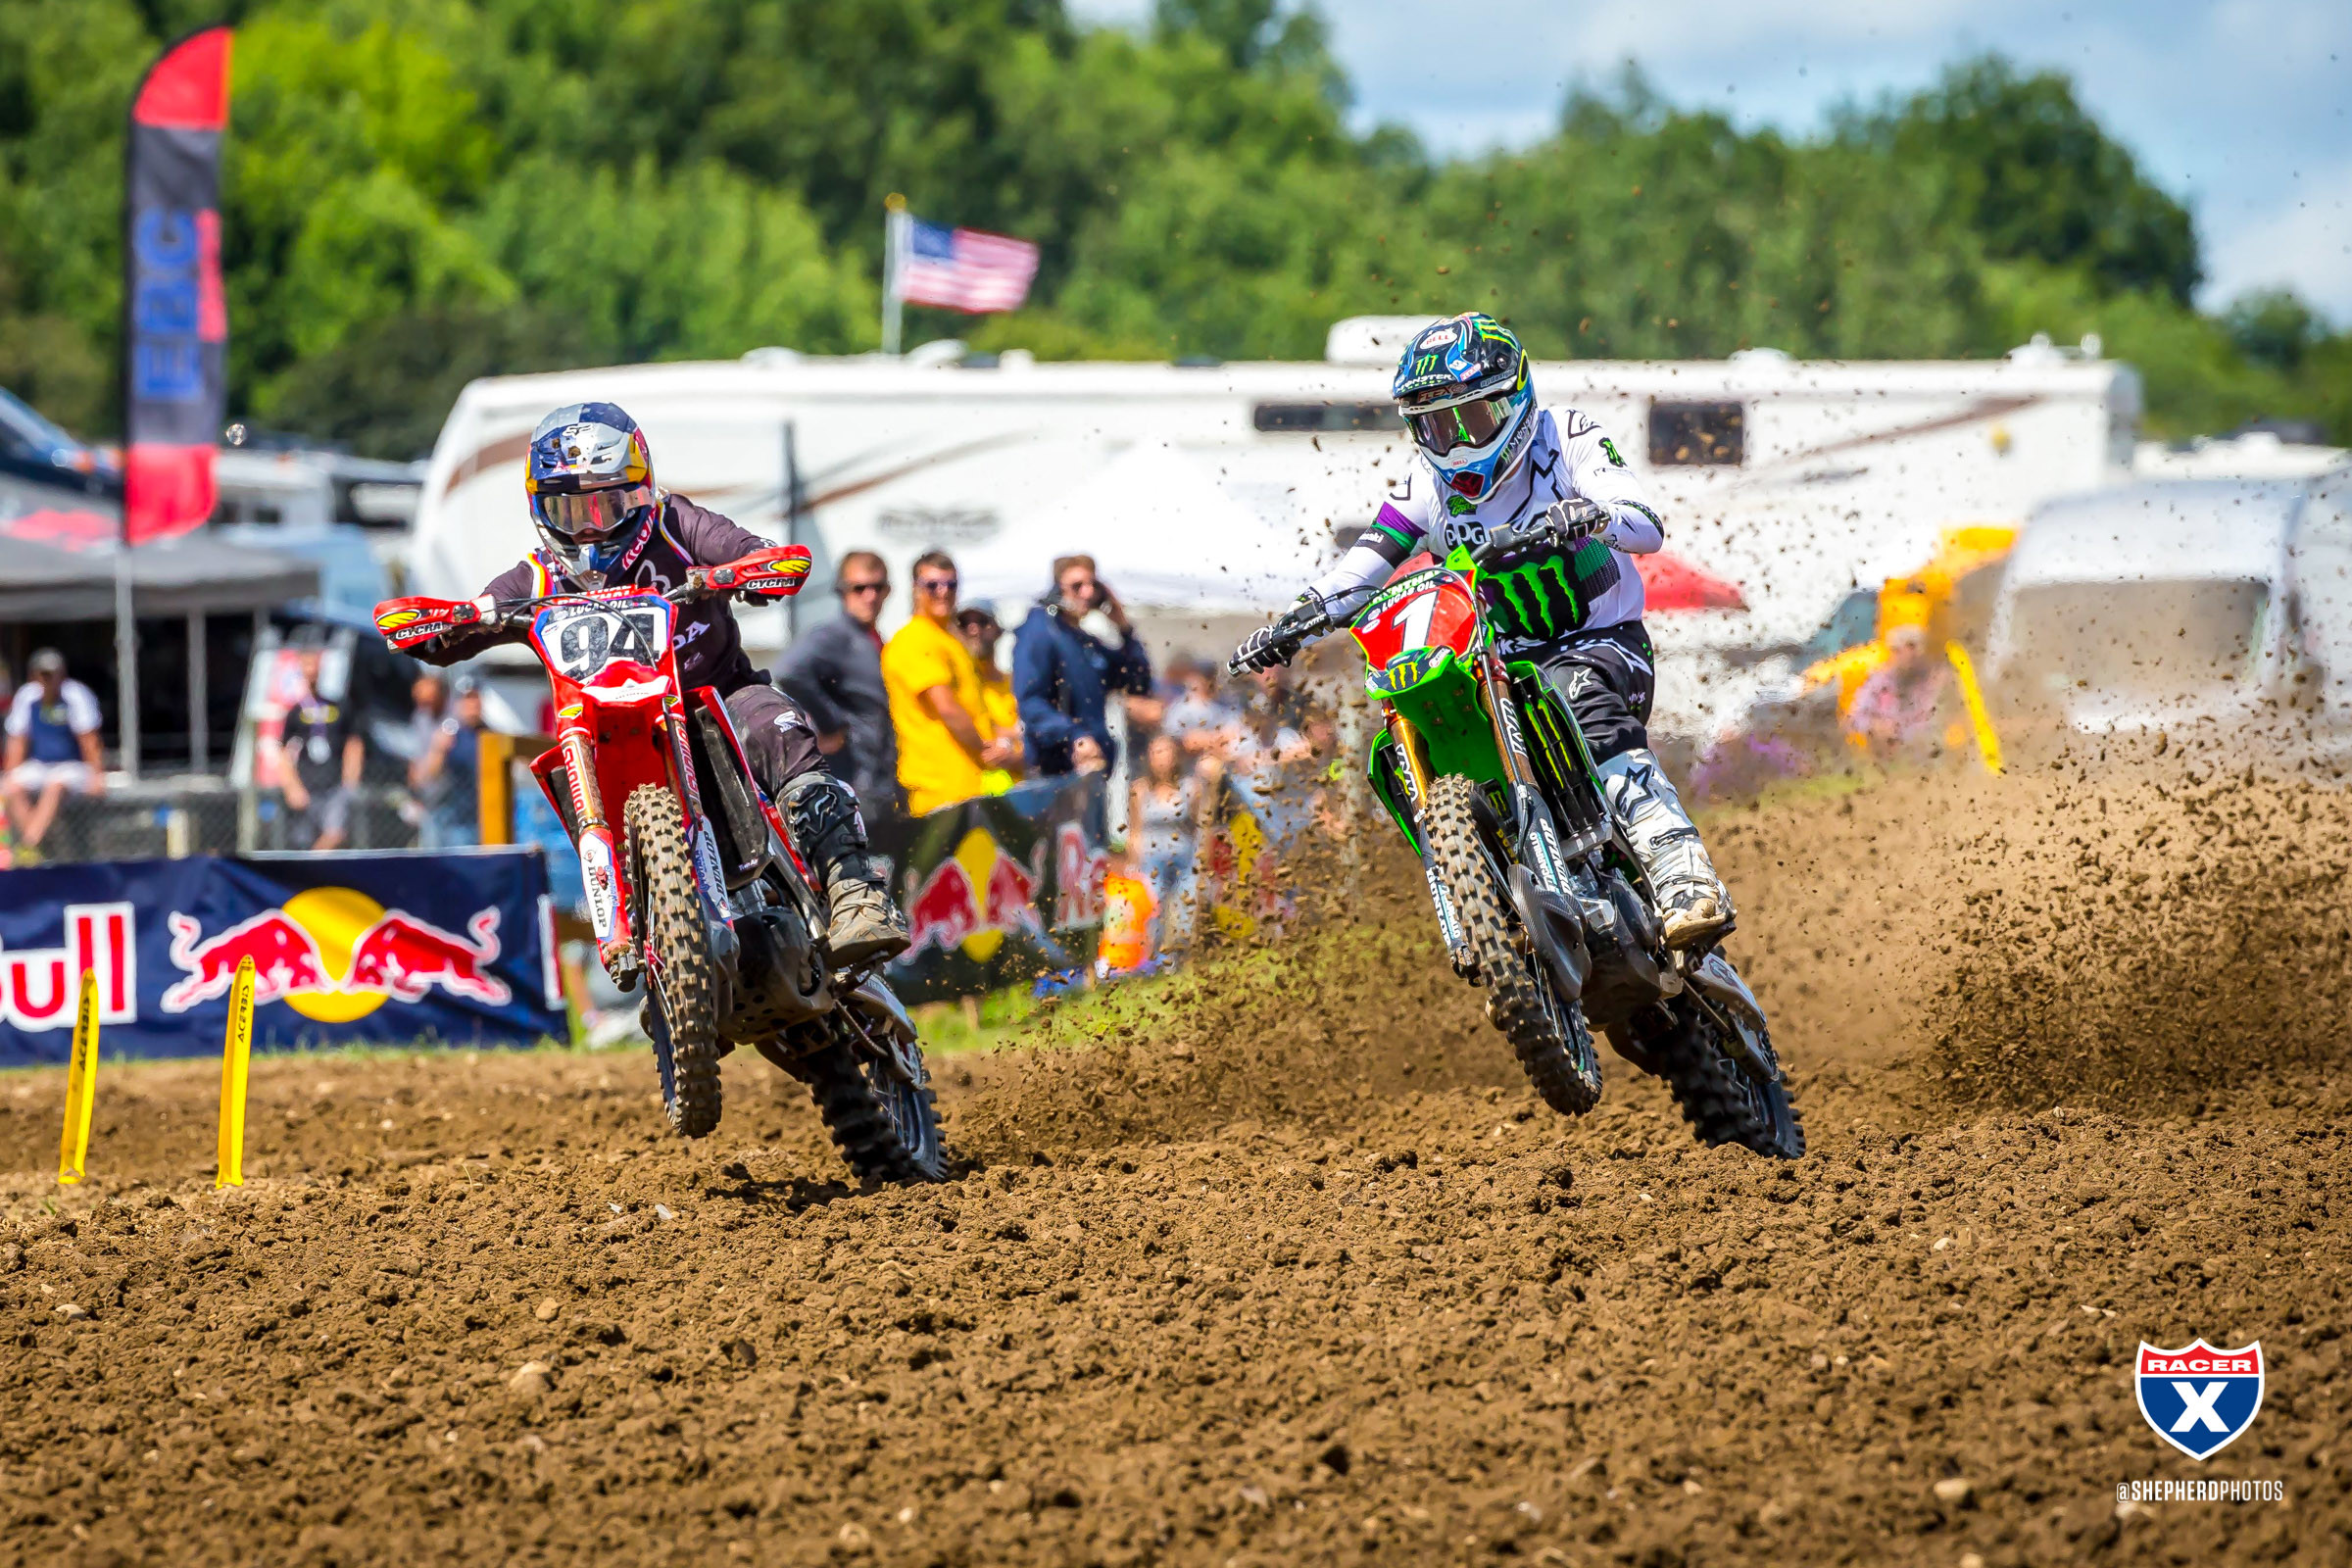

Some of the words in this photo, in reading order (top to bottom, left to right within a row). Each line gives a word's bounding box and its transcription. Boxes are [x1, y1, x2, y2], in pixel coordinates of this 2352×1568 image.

[1396, 373, 1452, 393] MONSTER
[609, 600, 629, 610] OIL
[1382, 586, 1415, 612] LUCAS
[1417, 580, 1437, 592] OIL
[1393, 589, 1439, 652] 1
[561, 613, 660, 681] 94
[704, 830, 724, 897] DUNLOP
[1540, 818, 1574, 896] DUNLOP
[588, 865, 608, 928] DUNLOP
[0, 914, 125, 1019] ull
[237, 984, 249, 1044] ACERBIS
